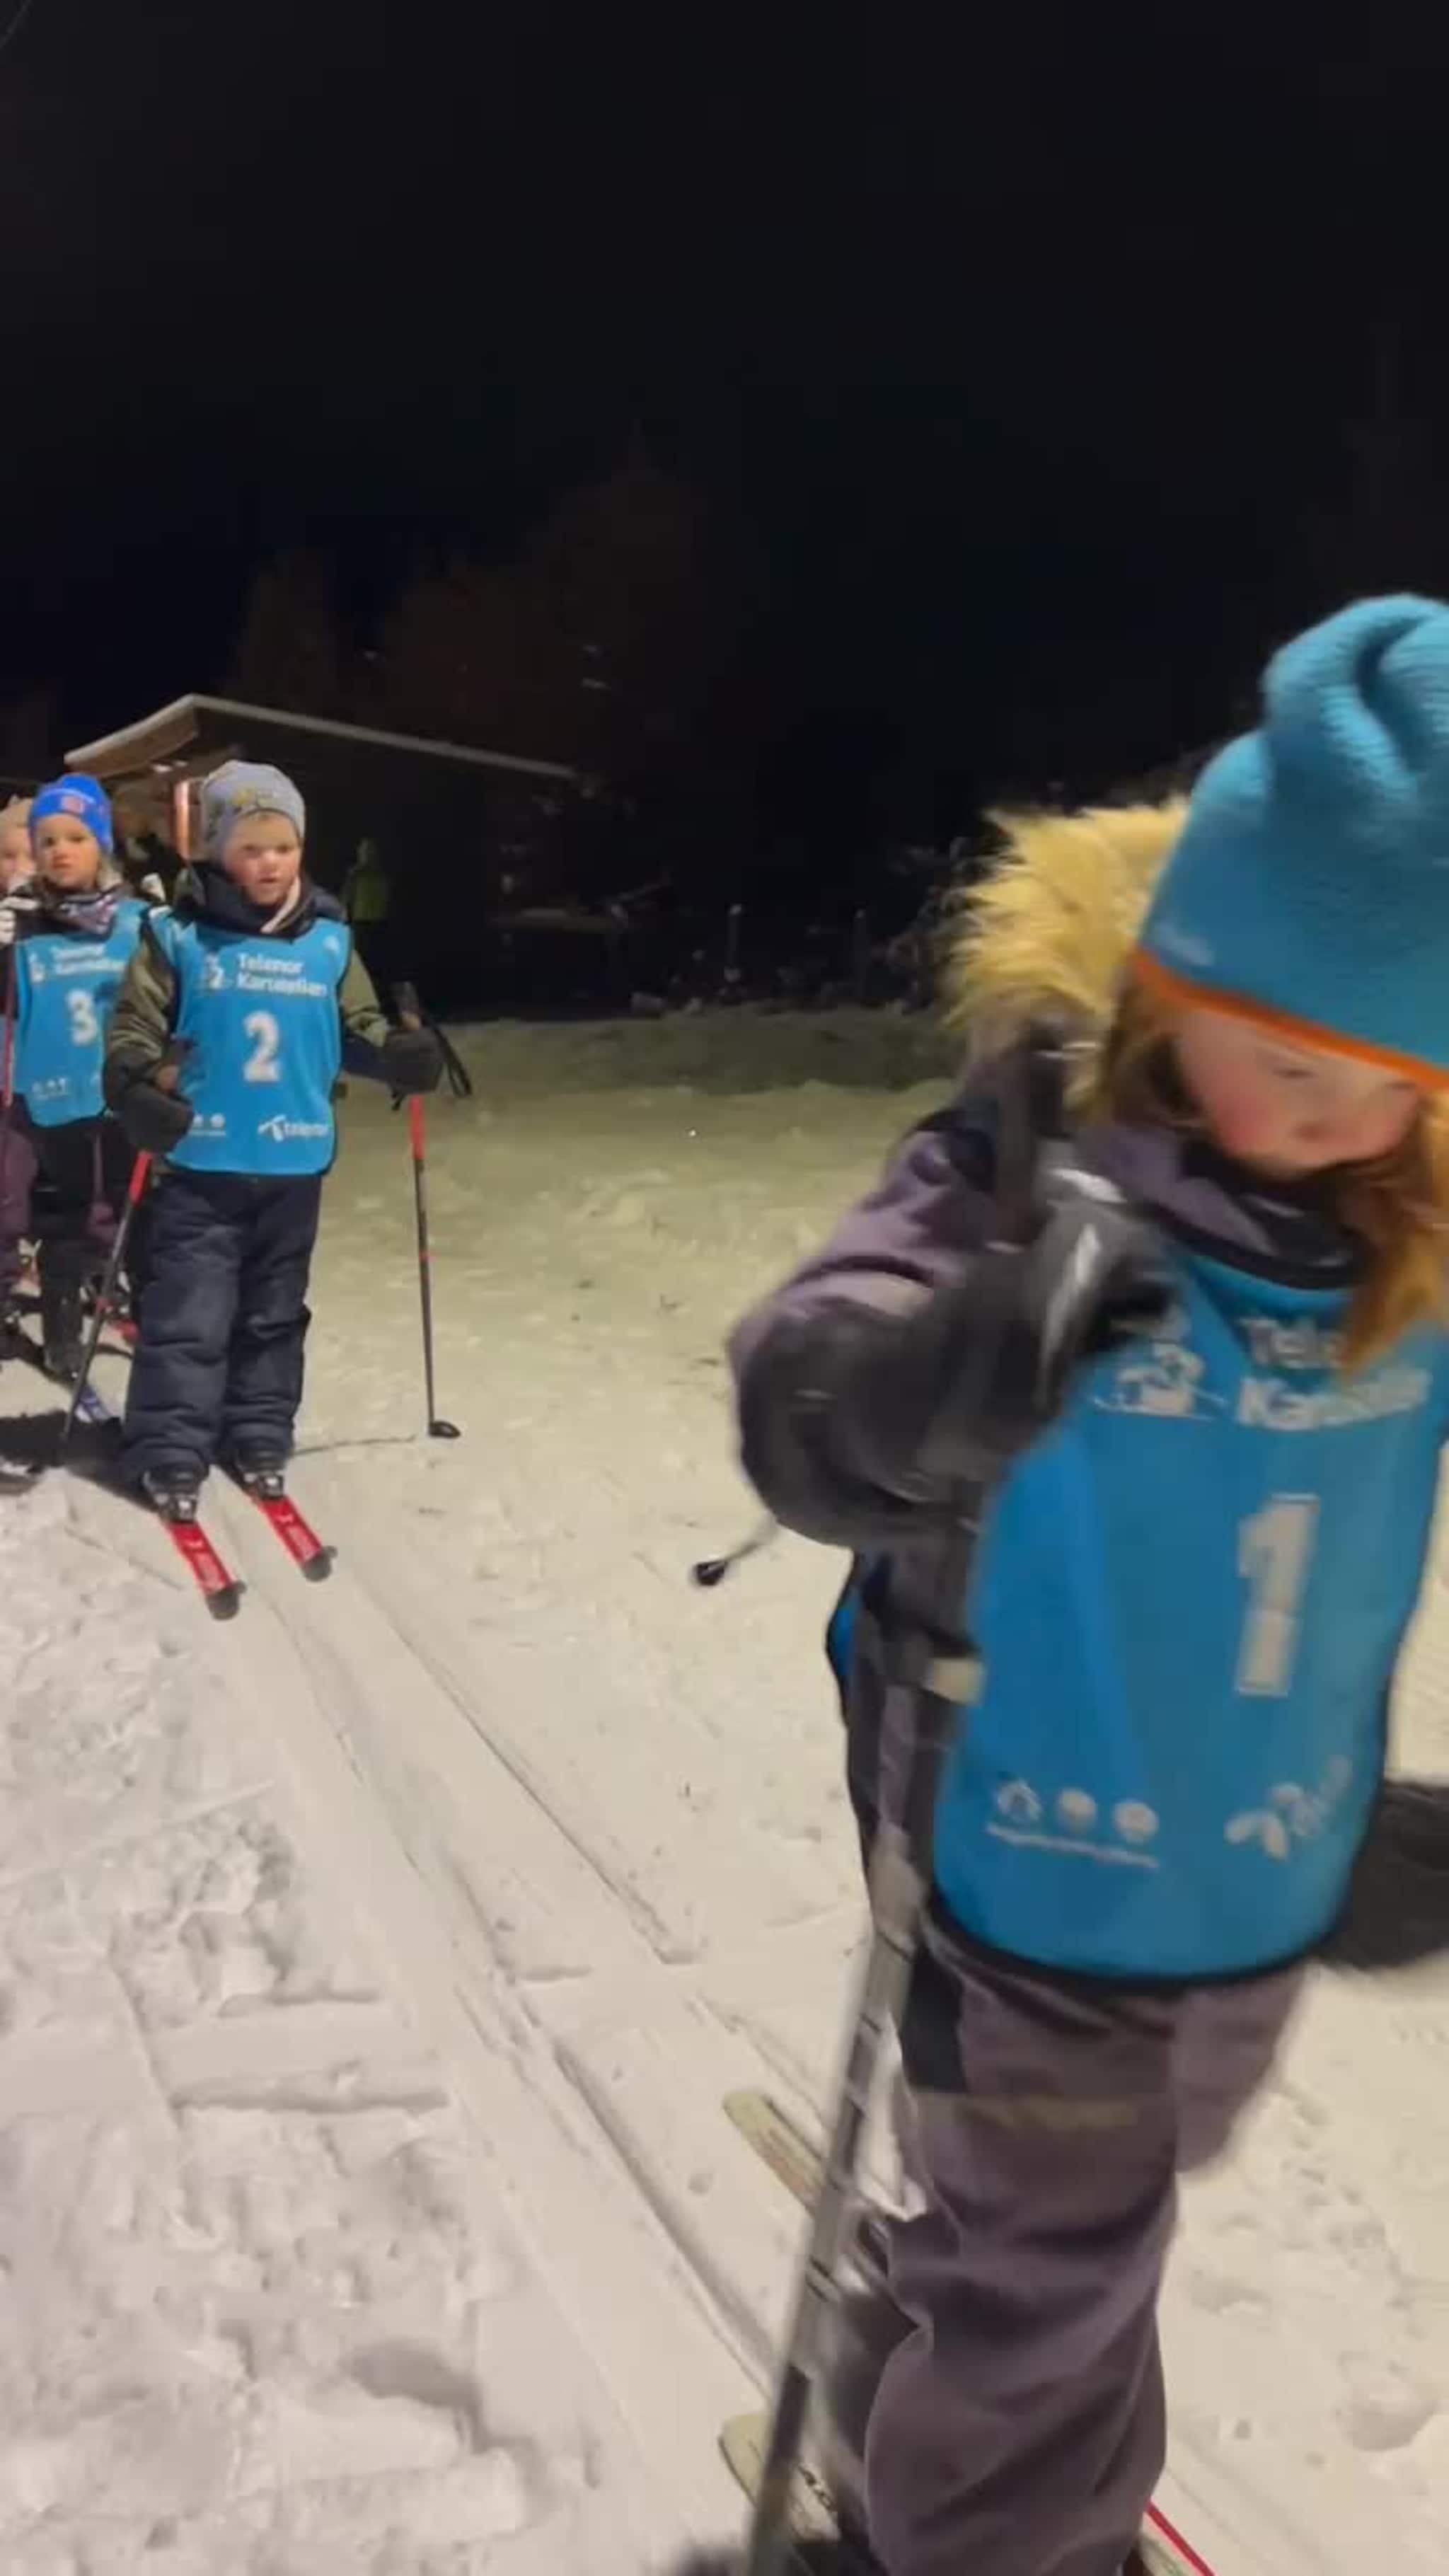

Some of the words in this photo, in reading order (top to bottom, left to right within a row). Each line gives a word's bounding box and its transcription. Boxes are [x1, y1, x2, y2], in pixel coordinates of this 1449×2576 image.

[65, 989, 98, 1046] 3
[243, 1011, 279, 1082] 2
[1235, 1493, 1320, 1697] 1
